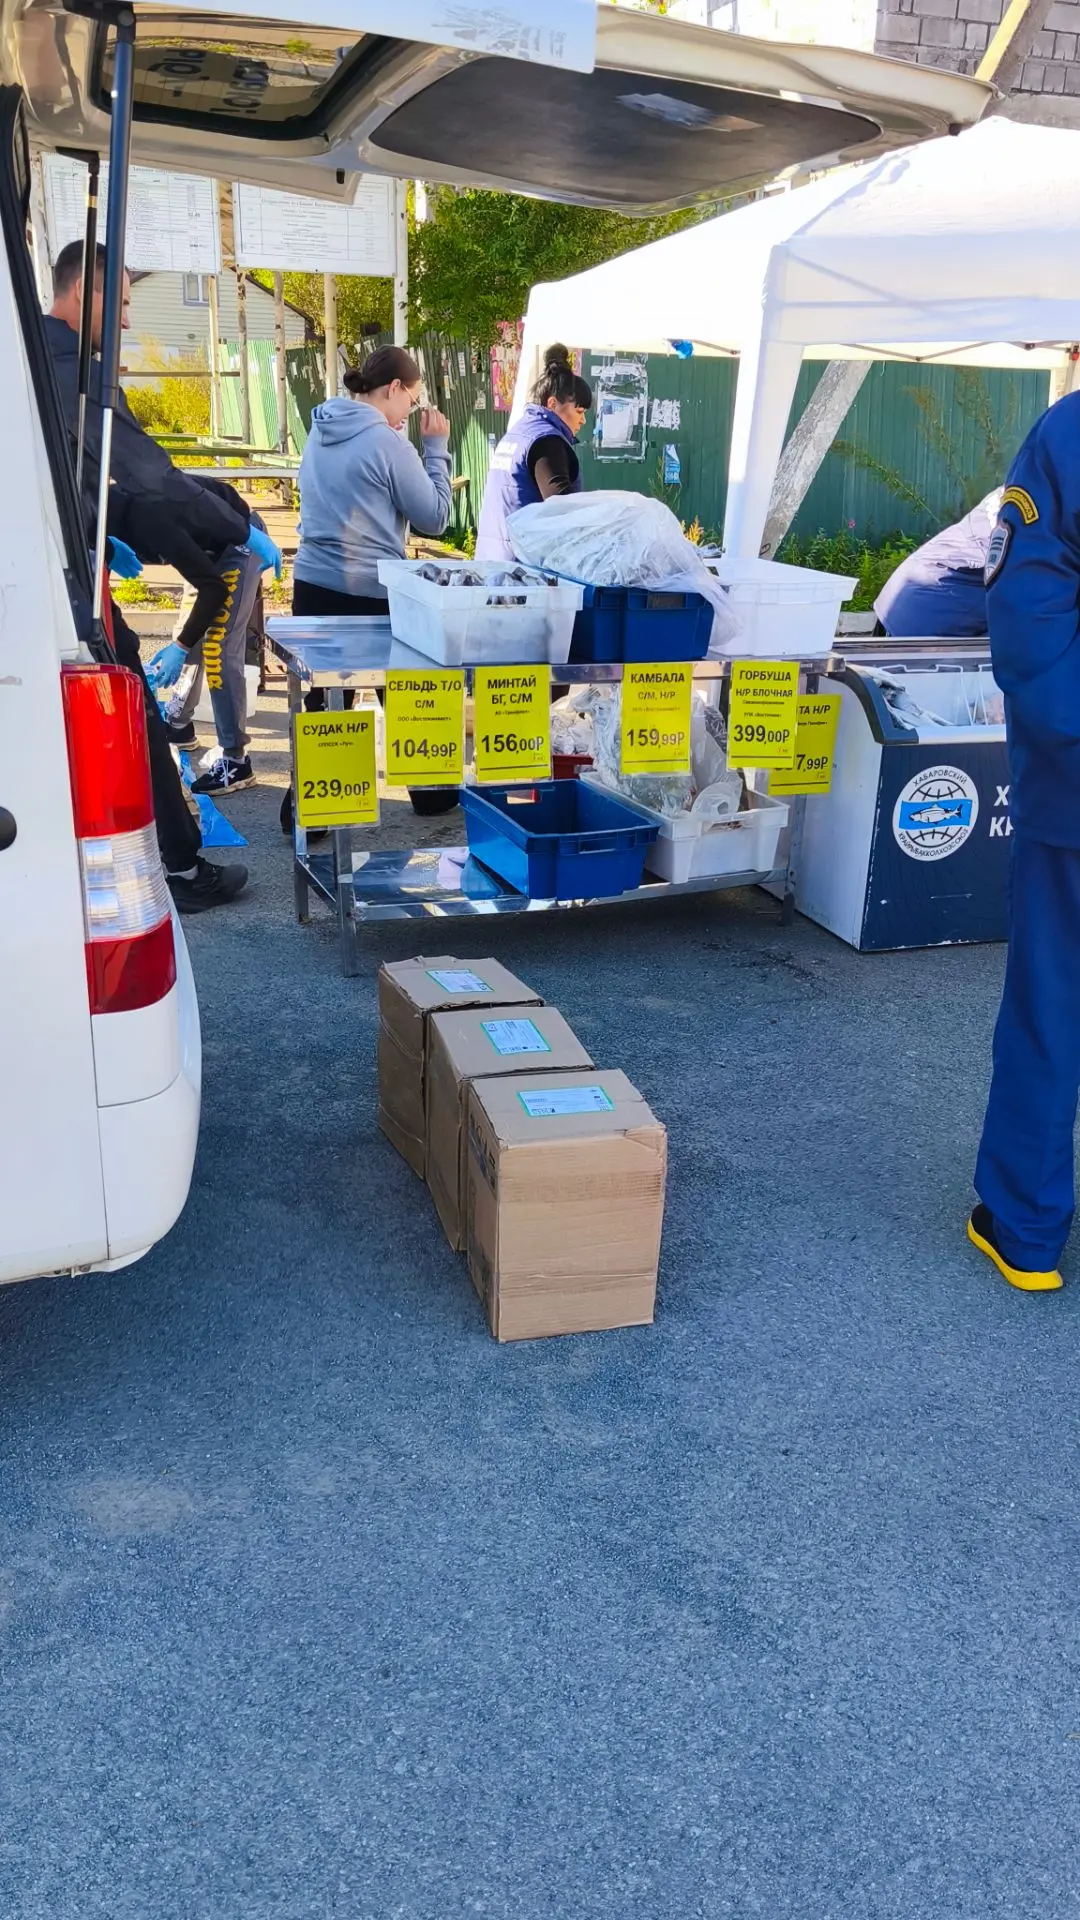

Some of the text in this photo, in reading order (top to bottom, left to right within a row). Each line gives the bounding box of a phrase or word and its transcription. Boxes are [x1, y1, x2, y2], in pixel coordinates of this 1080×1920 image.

[630, 672, 685, 683] КАМБАЛА
[739, 670, 792, 681] ГОРБУША
[388, 680, 462, 693] СЕЛЬДЬ Т/О
[487, 674, 537, 689] МИНТАЙ
[660, 690, 676, 700] Н/Р
[735, 688, 793, 698] Н/Р БЛОЧНАЯ
[415, 699, 435, 709] С/М
[491, 693, 533, 706] БГ, С/М
[813, 704, 831, 715] Н/Р
[303, 722, 369, 737] СУДАК Н/Р
[912, 769, 968, 787] ХАБАРОВСКИЙ
